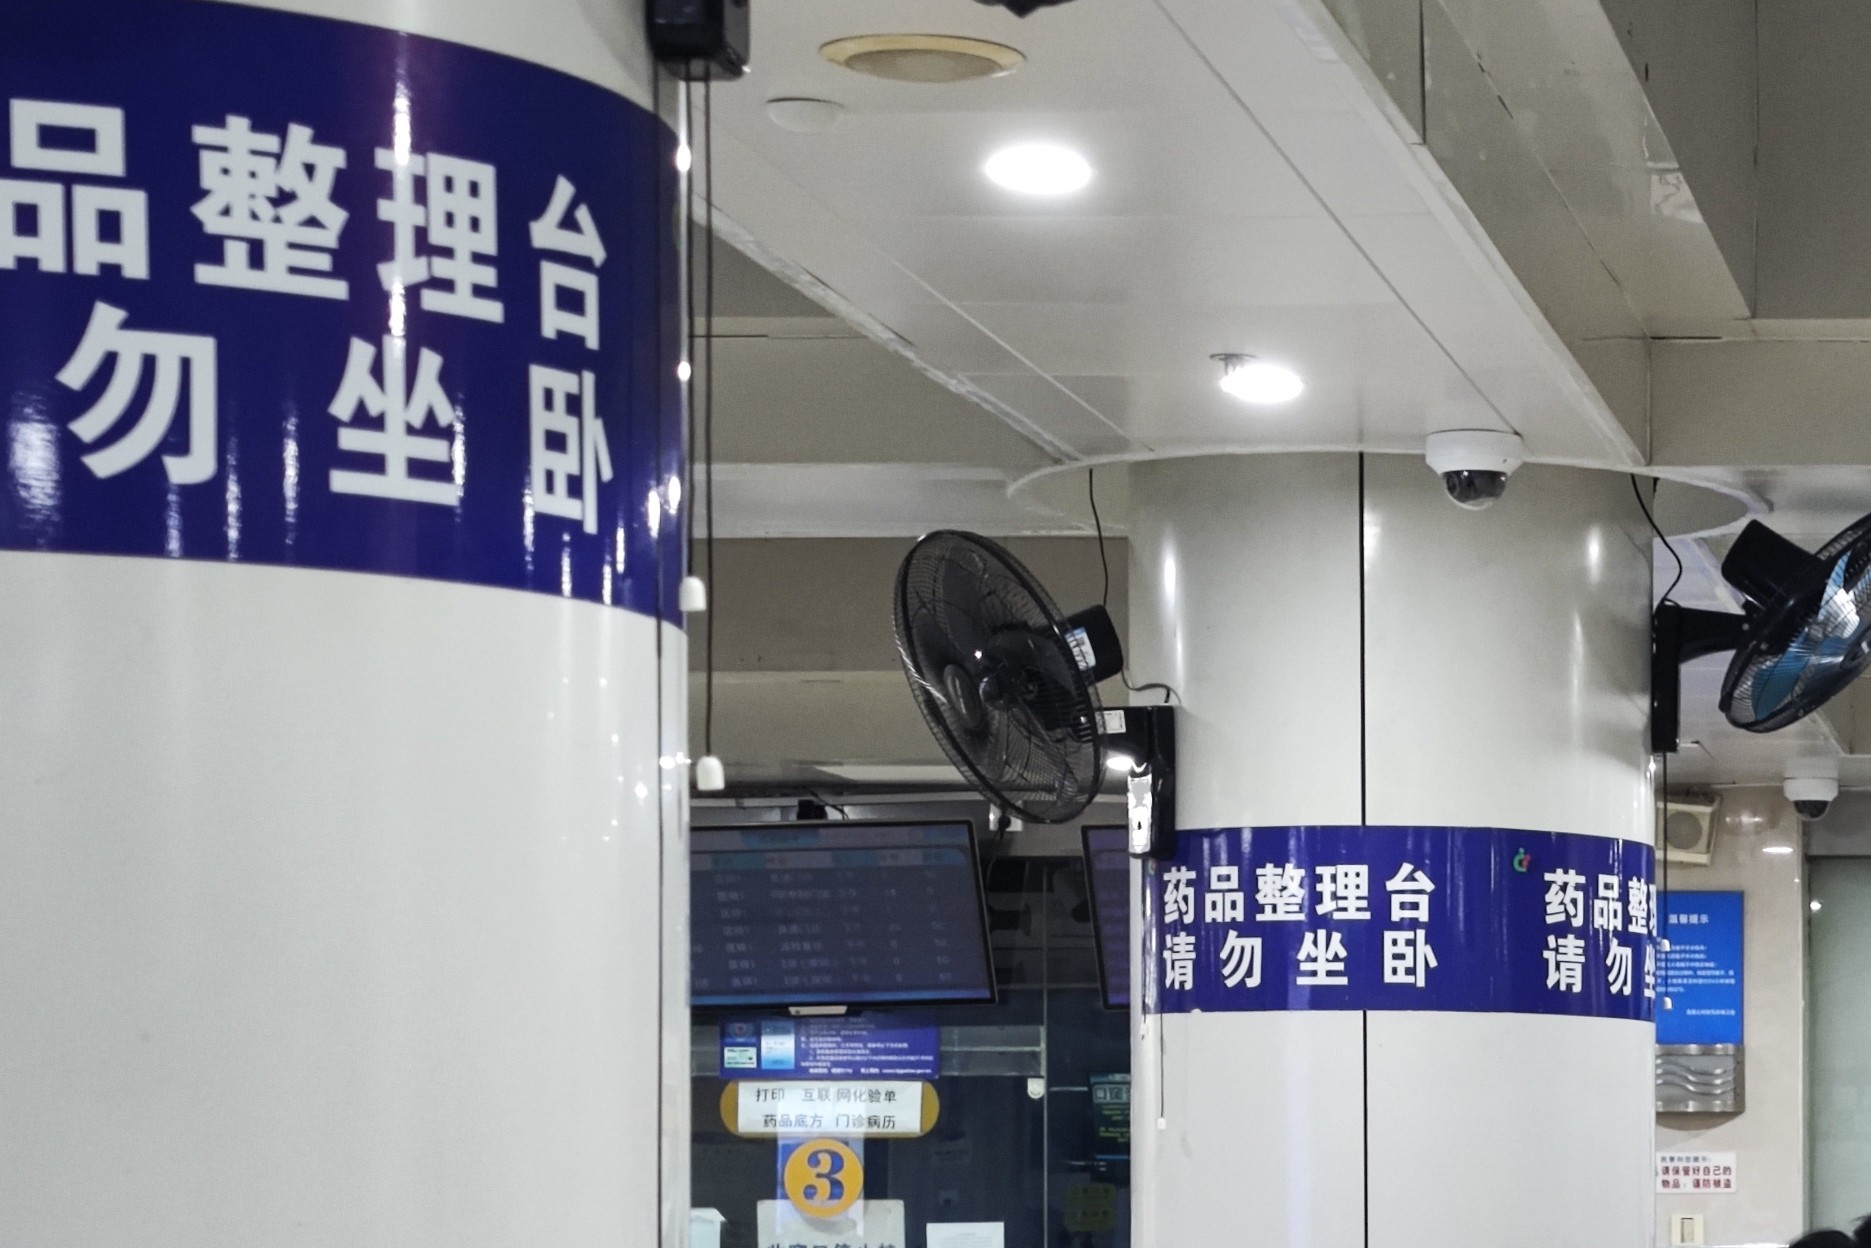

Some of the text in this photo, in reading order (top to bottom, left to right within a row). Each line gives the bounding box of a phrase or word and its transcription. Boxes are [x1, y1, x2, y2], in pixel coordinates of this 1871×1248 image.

[0, 98, 607, 350] 品整理台
[1163, 862, 1435, 925] 药品整理台
[1162, 929, 1438, 990] 请勿坐卧
[756, 1088, 785, 1103] 打印
[763, 1114, 896, 1129] 药品底方 门诊病历
[803, 1149, 845, 1201] 3
